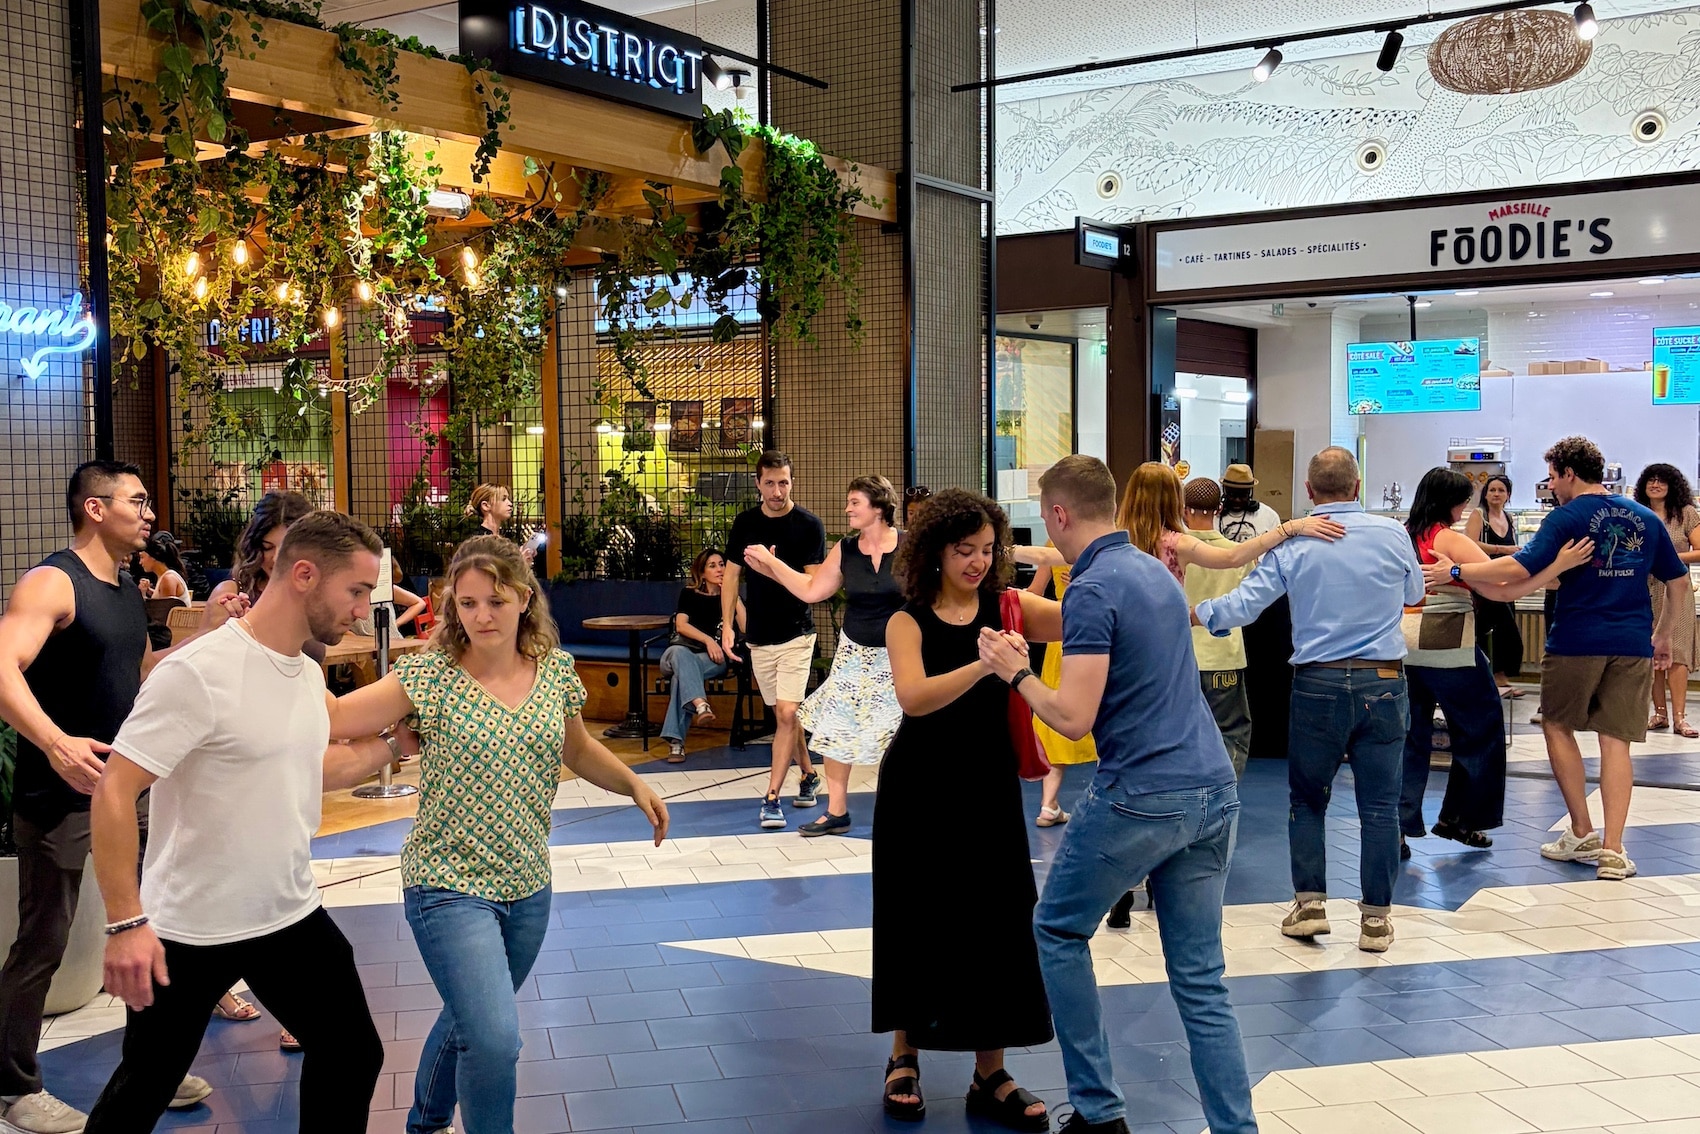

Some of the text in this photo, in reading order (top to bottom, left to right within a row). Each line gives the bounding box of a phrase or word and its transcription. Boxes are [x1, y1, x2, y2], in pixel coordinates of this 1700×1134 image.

[529, 5, 703, 91] DISTRICT
[1488, 202, 1551, 222] MARSEILLE
[1123, 243, 1131, 256] 12
[1184, 240, 1361, 264] CAFÉ TARTINES SALADES SPÉCIALITÉS
[1589, 507, 1646, 533] MIAMI BEACH
